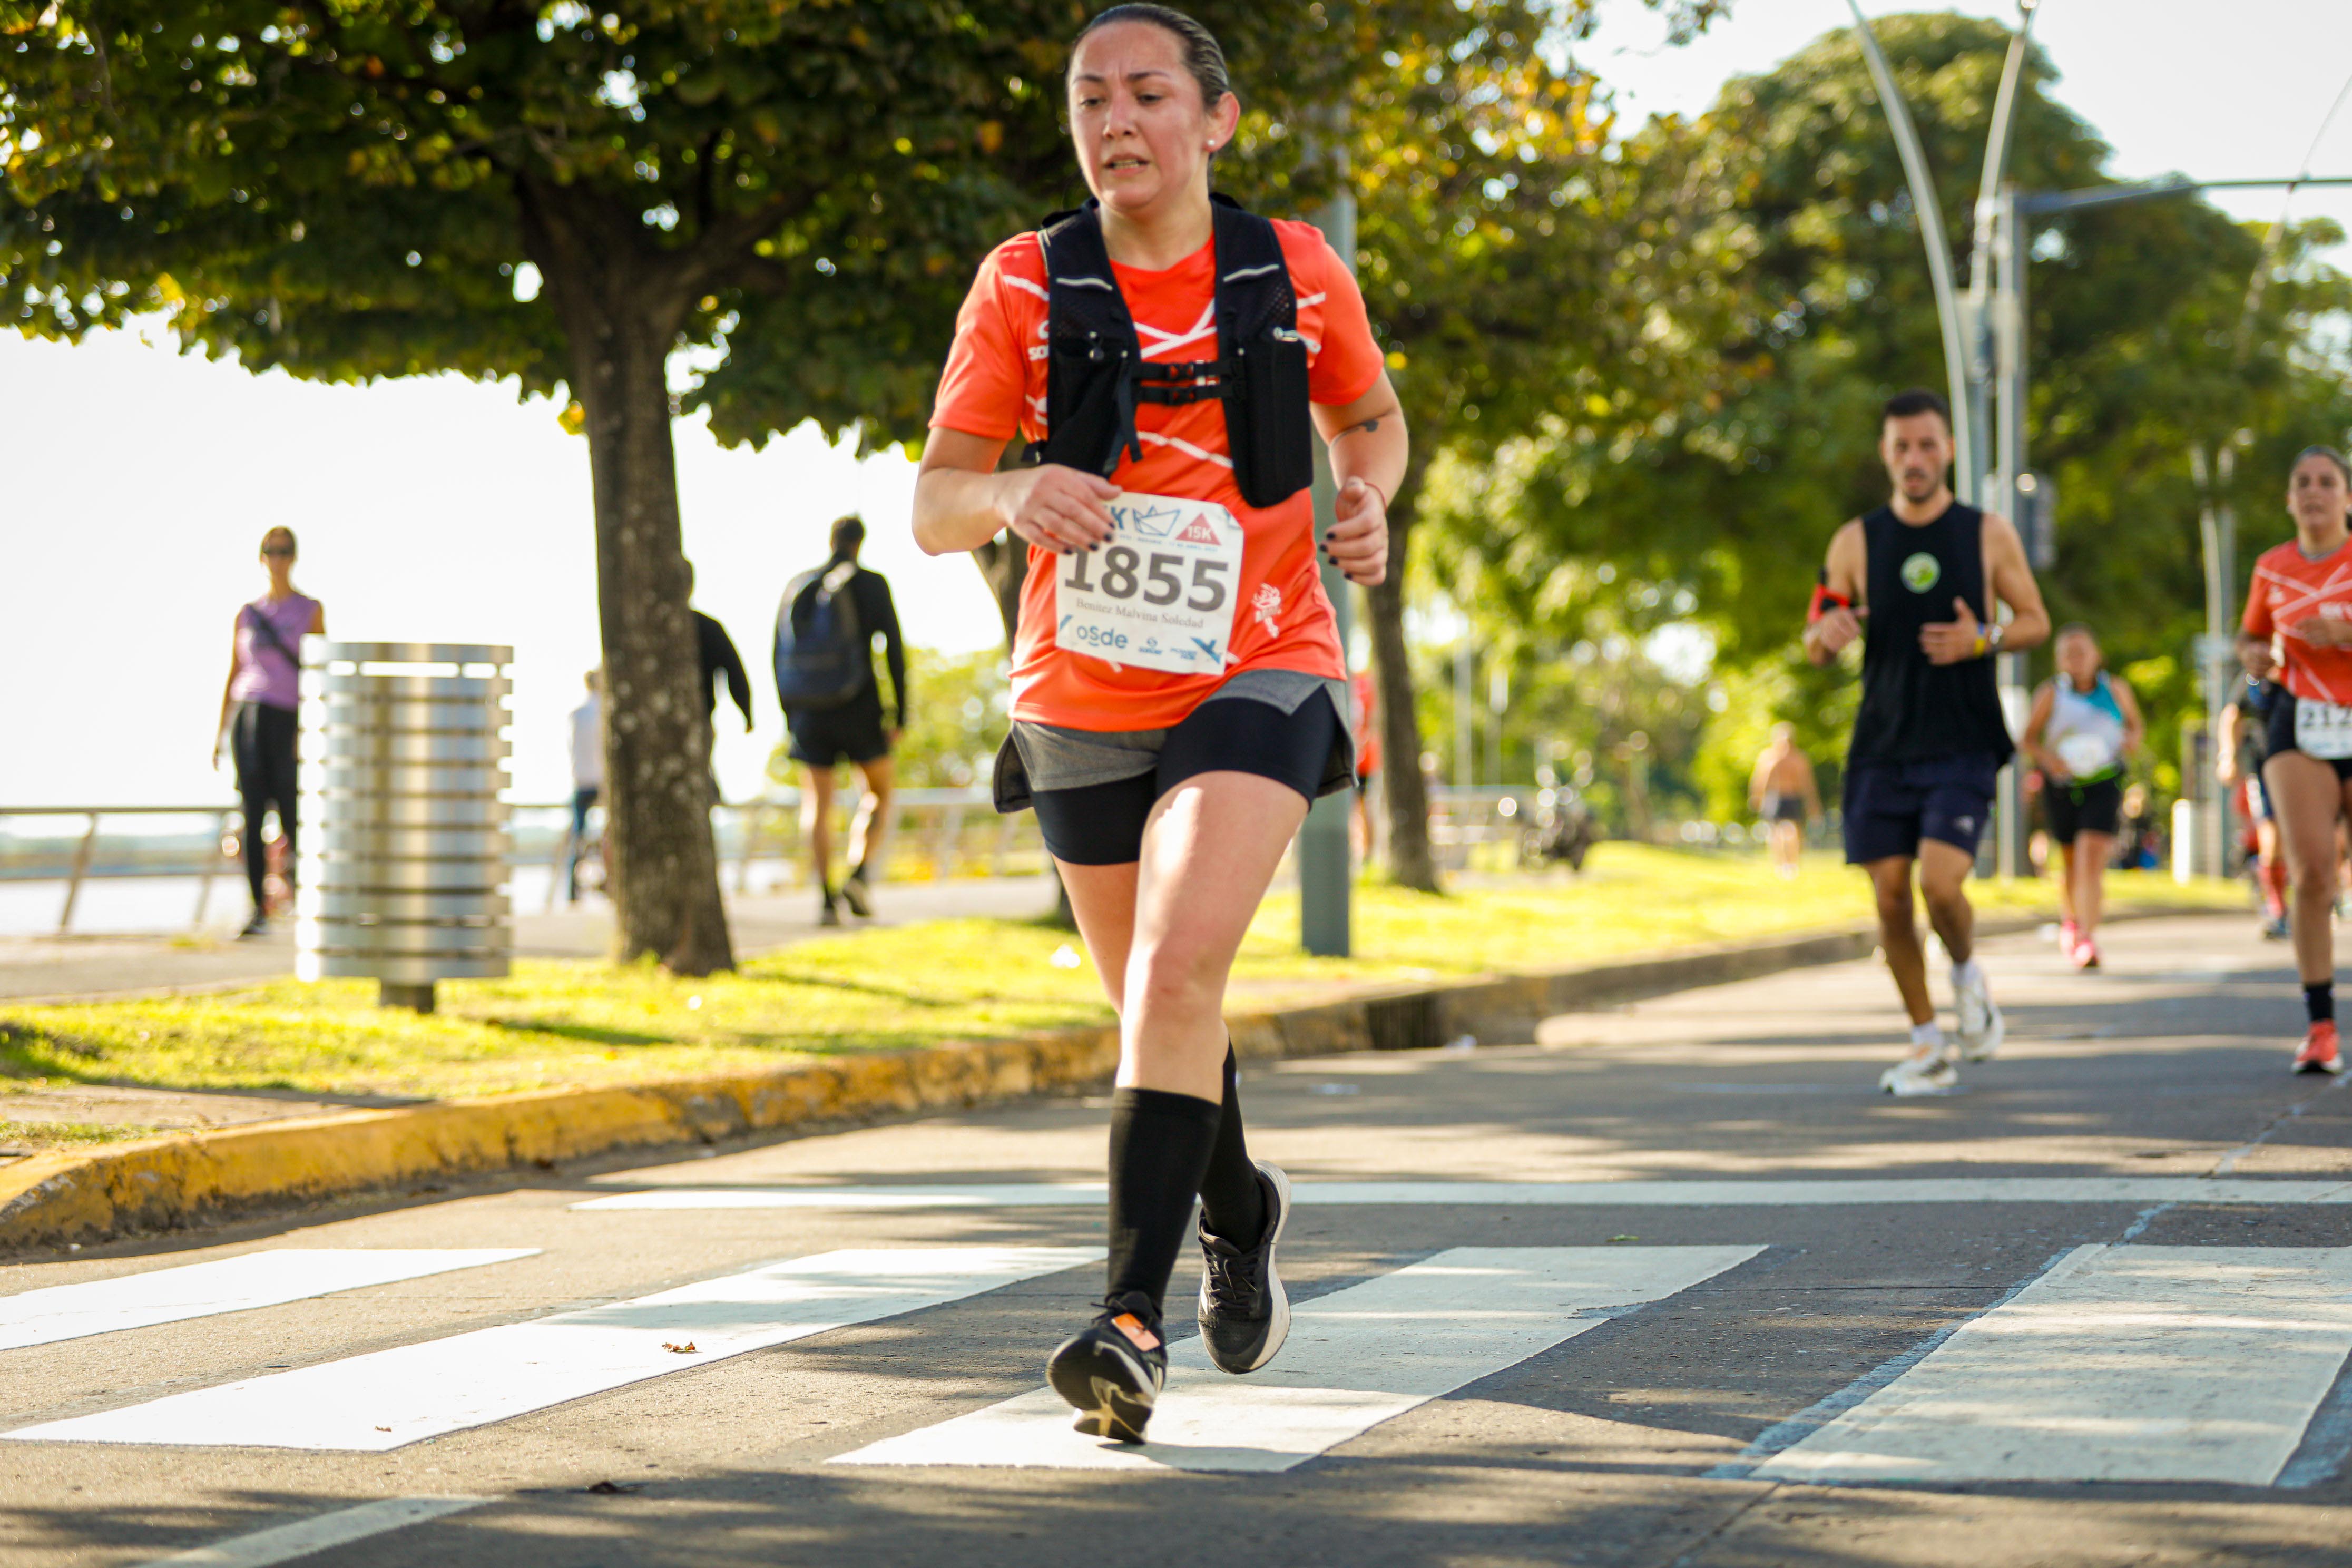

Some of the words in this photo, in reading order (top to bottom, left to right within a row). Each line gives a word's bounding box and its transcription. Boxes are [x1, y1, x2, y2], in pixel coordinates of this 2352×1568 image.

[1188, 526, 1212, 541] 15K
[1064, 545, 1229, 612] 1855
[1076, 597, 1112, 614] Benitez
[1115, 605, 1158, 622] Malvina
[1161, 613, 1204, 628] Soledad
[1076, 625, 1129, 649] osde
